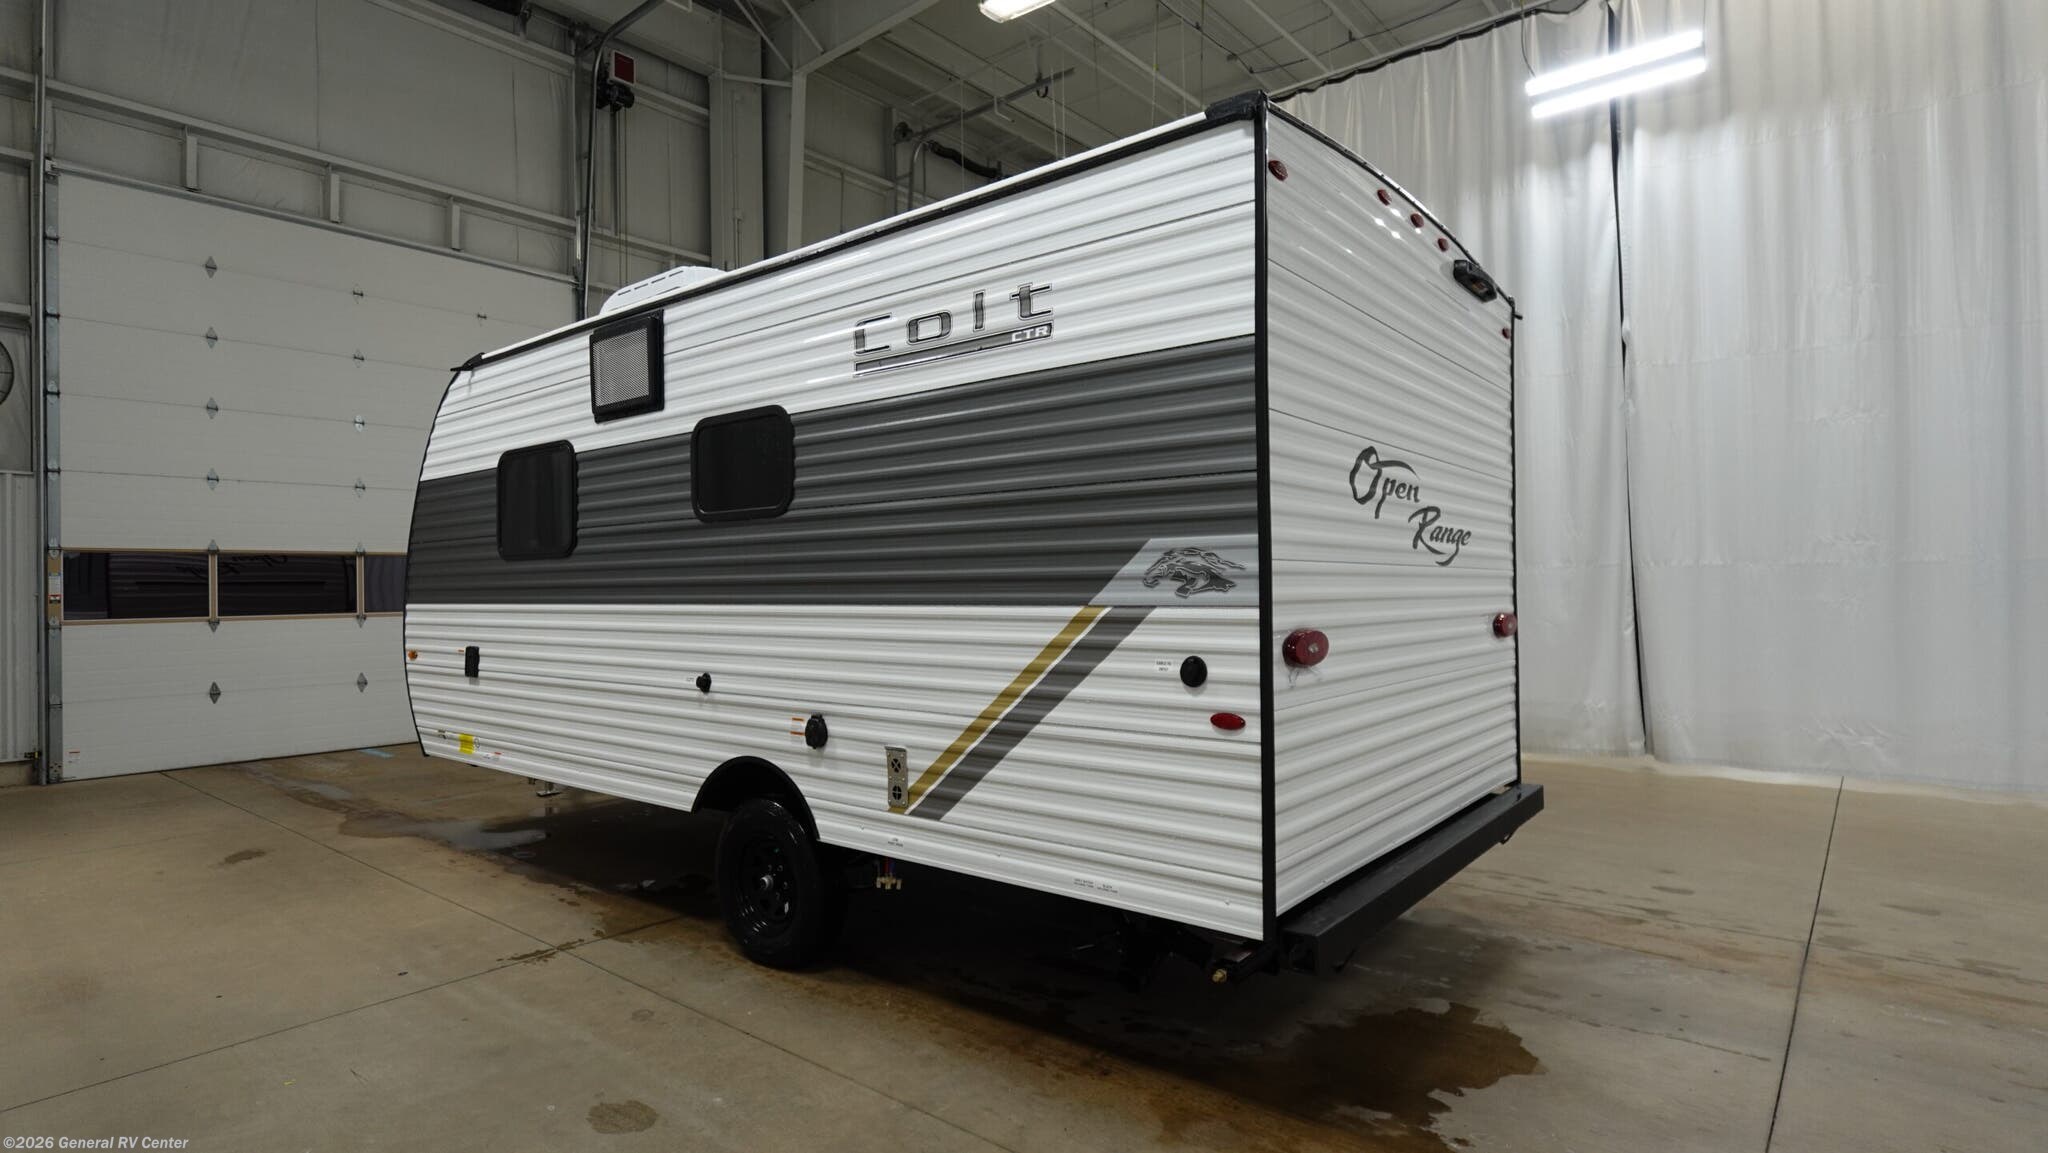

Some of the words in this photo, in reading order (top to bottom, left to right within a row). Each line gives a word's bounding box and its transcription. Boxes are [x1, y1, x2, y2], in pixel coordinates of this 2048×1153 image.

[853, 282, 1052, 355] Colt
[1011, 326, 1049, 343] CTR
[1349, 446, 1420, 519] Open
[1408, 506, 1472, 566] Range
